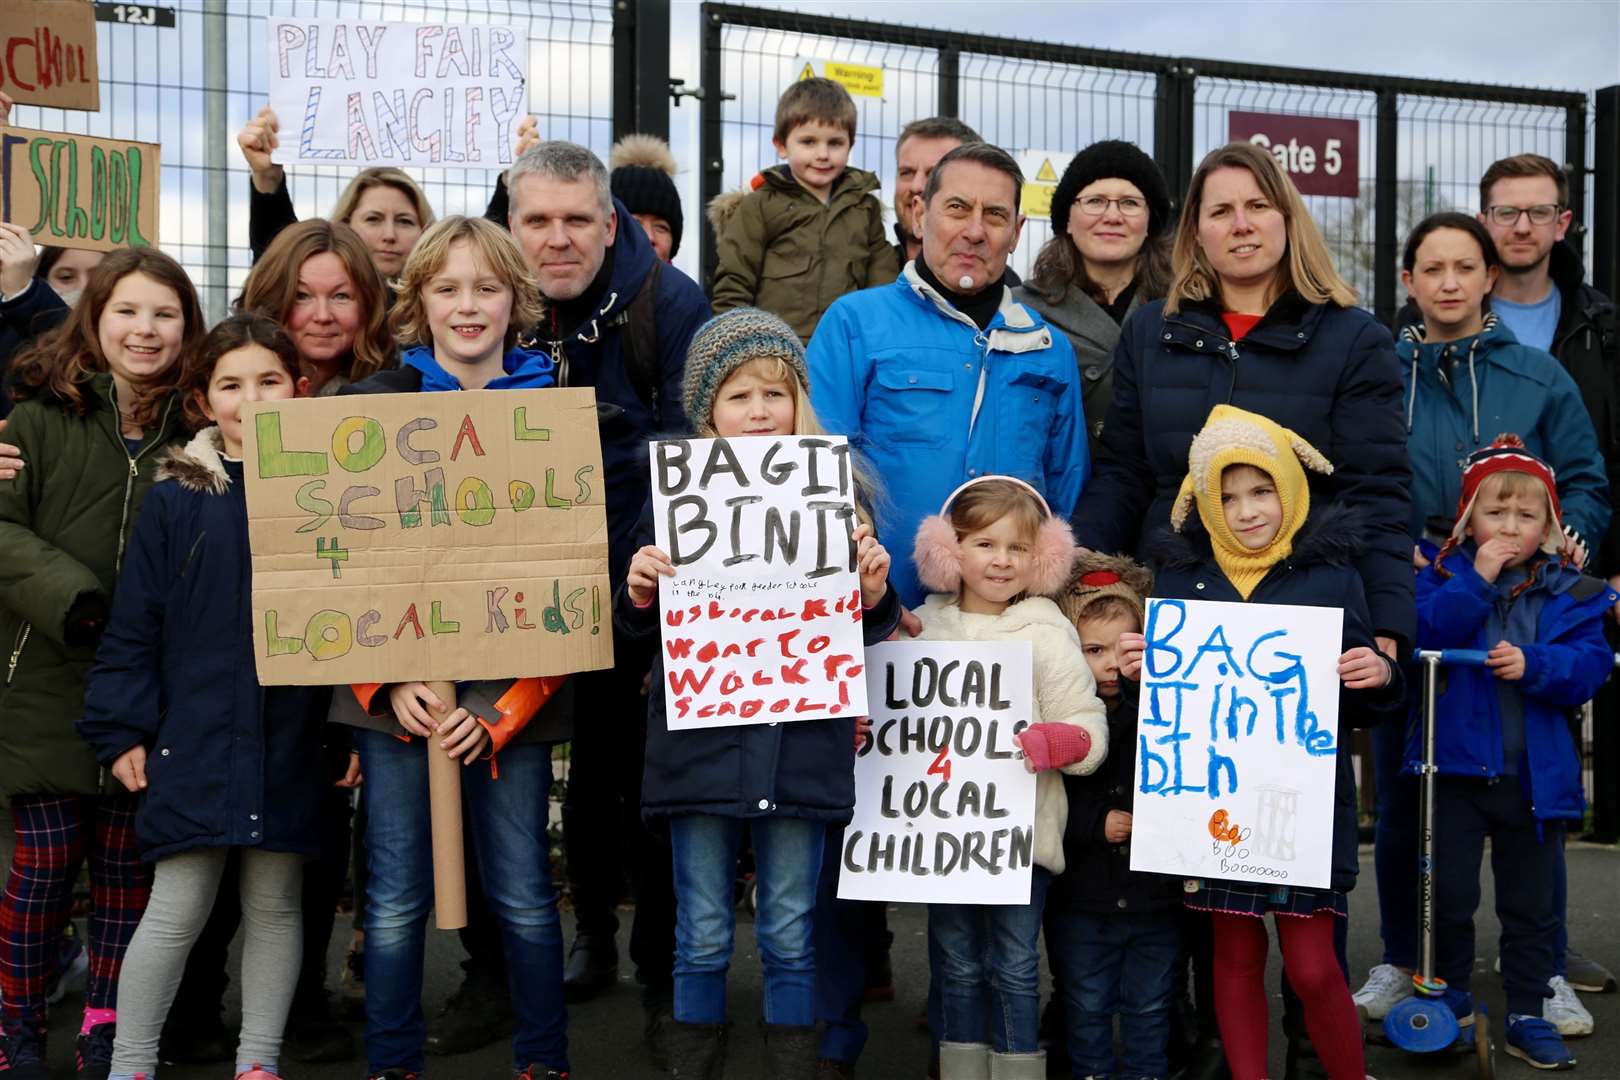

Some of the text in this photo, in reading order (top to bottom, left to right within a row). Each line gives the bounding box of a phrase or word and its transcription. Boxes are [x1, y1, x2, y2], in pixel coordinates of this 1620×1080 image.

[113, 6, 156, 25] 12J
[0, 26, 90, 92] CHOOL
[277, 24, 523, 80] PLAY FAIR
[299, 86, 525, 164] LANGLEY
[1323, 138, 1342, 175] 5
[255, 406, 551, 479] LOCAL
[295, 464, 594, 533] SCHOOLS
[316, 536, 349, 579] 4
[265, 600, 461, 662] LOCAL
[1145, 598, 1302, 684] BAG
[885, 657, 1012, 710] LOCAL
[926, 744, 952, 783] 4
[881, 775, 1010, 819] LOCAL
